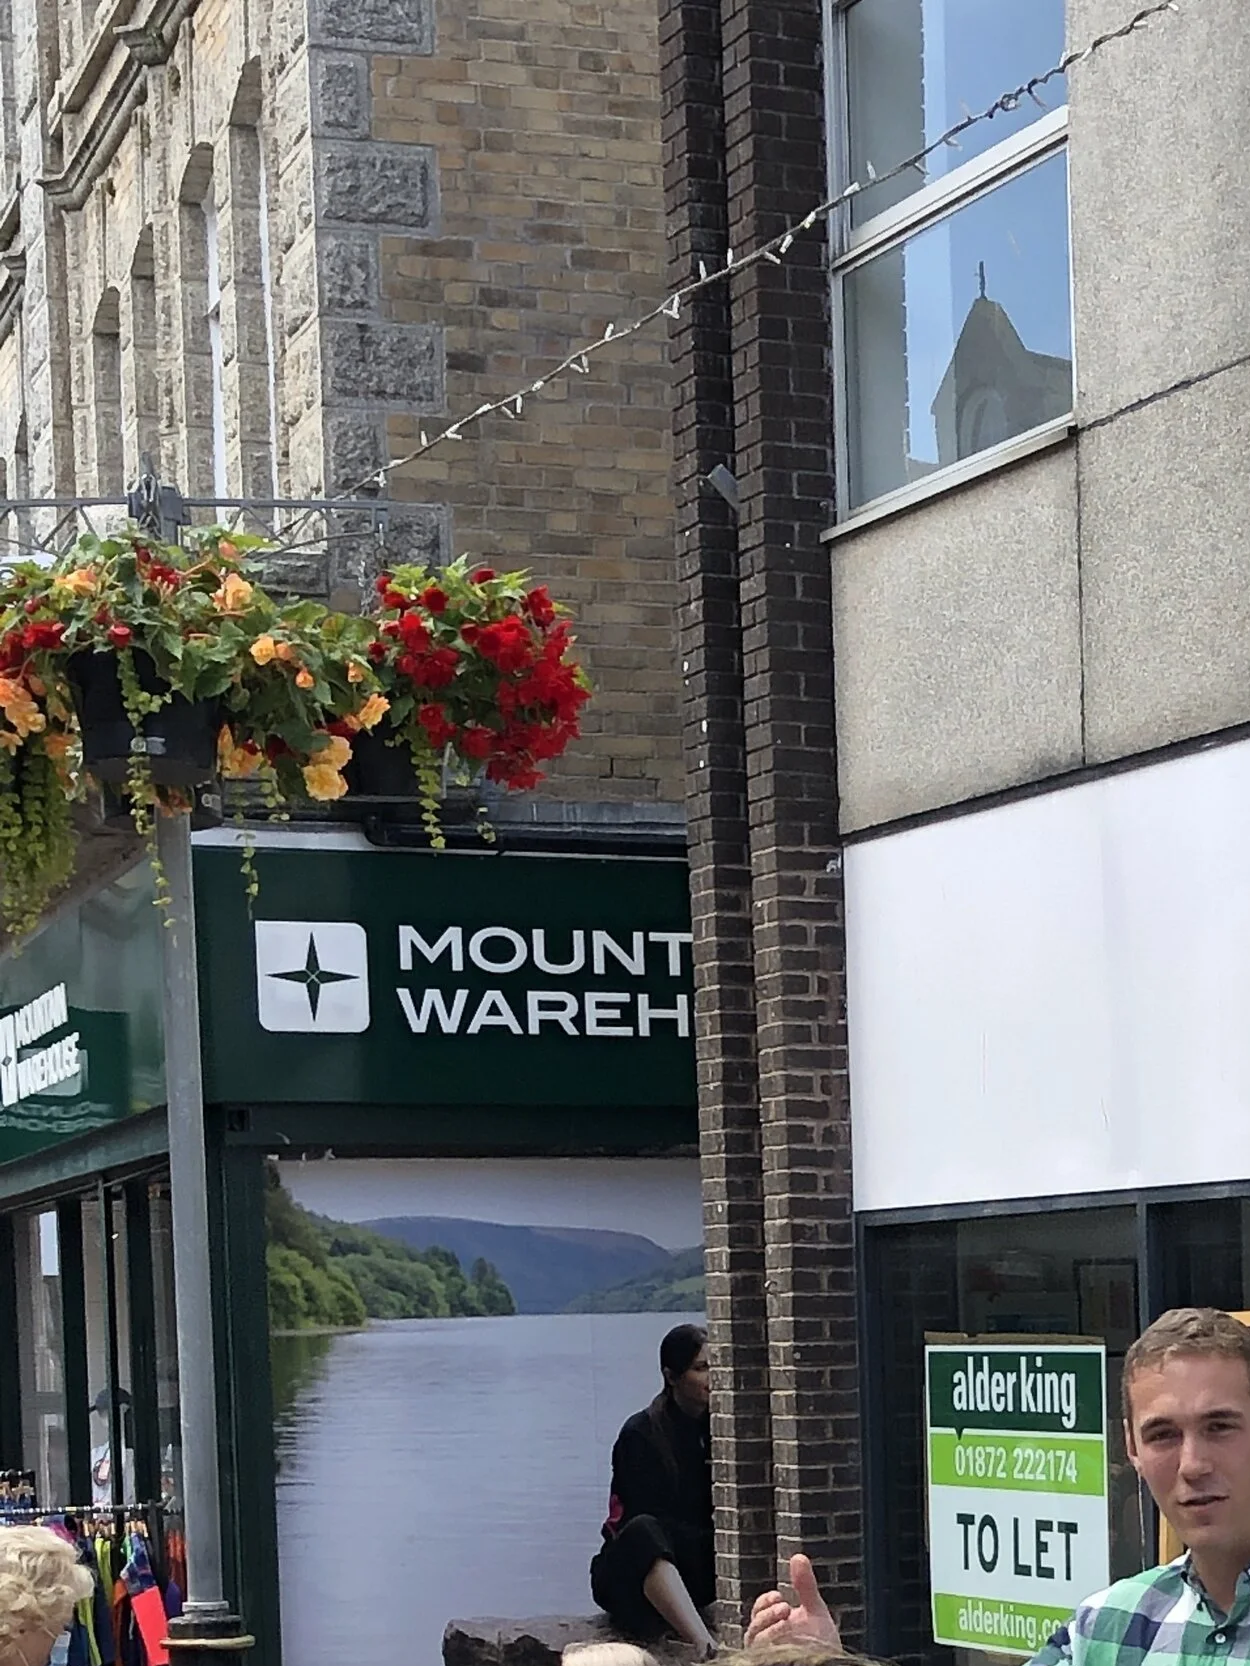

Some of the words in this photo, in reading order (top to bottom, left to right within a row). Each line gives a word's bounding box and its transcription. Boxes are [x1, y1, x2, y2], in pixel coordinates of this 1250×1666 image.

[398, 924, 694, 977] MOUNT
[396, 987, 690, 1038] WAREH
[955, 1445, 1007, 1479] 01872
[1013, 1447, 1078, 1484] 222174
[956, 1512, 999, 1574] TO
[1013, 1517, 1079, 1581] LET
